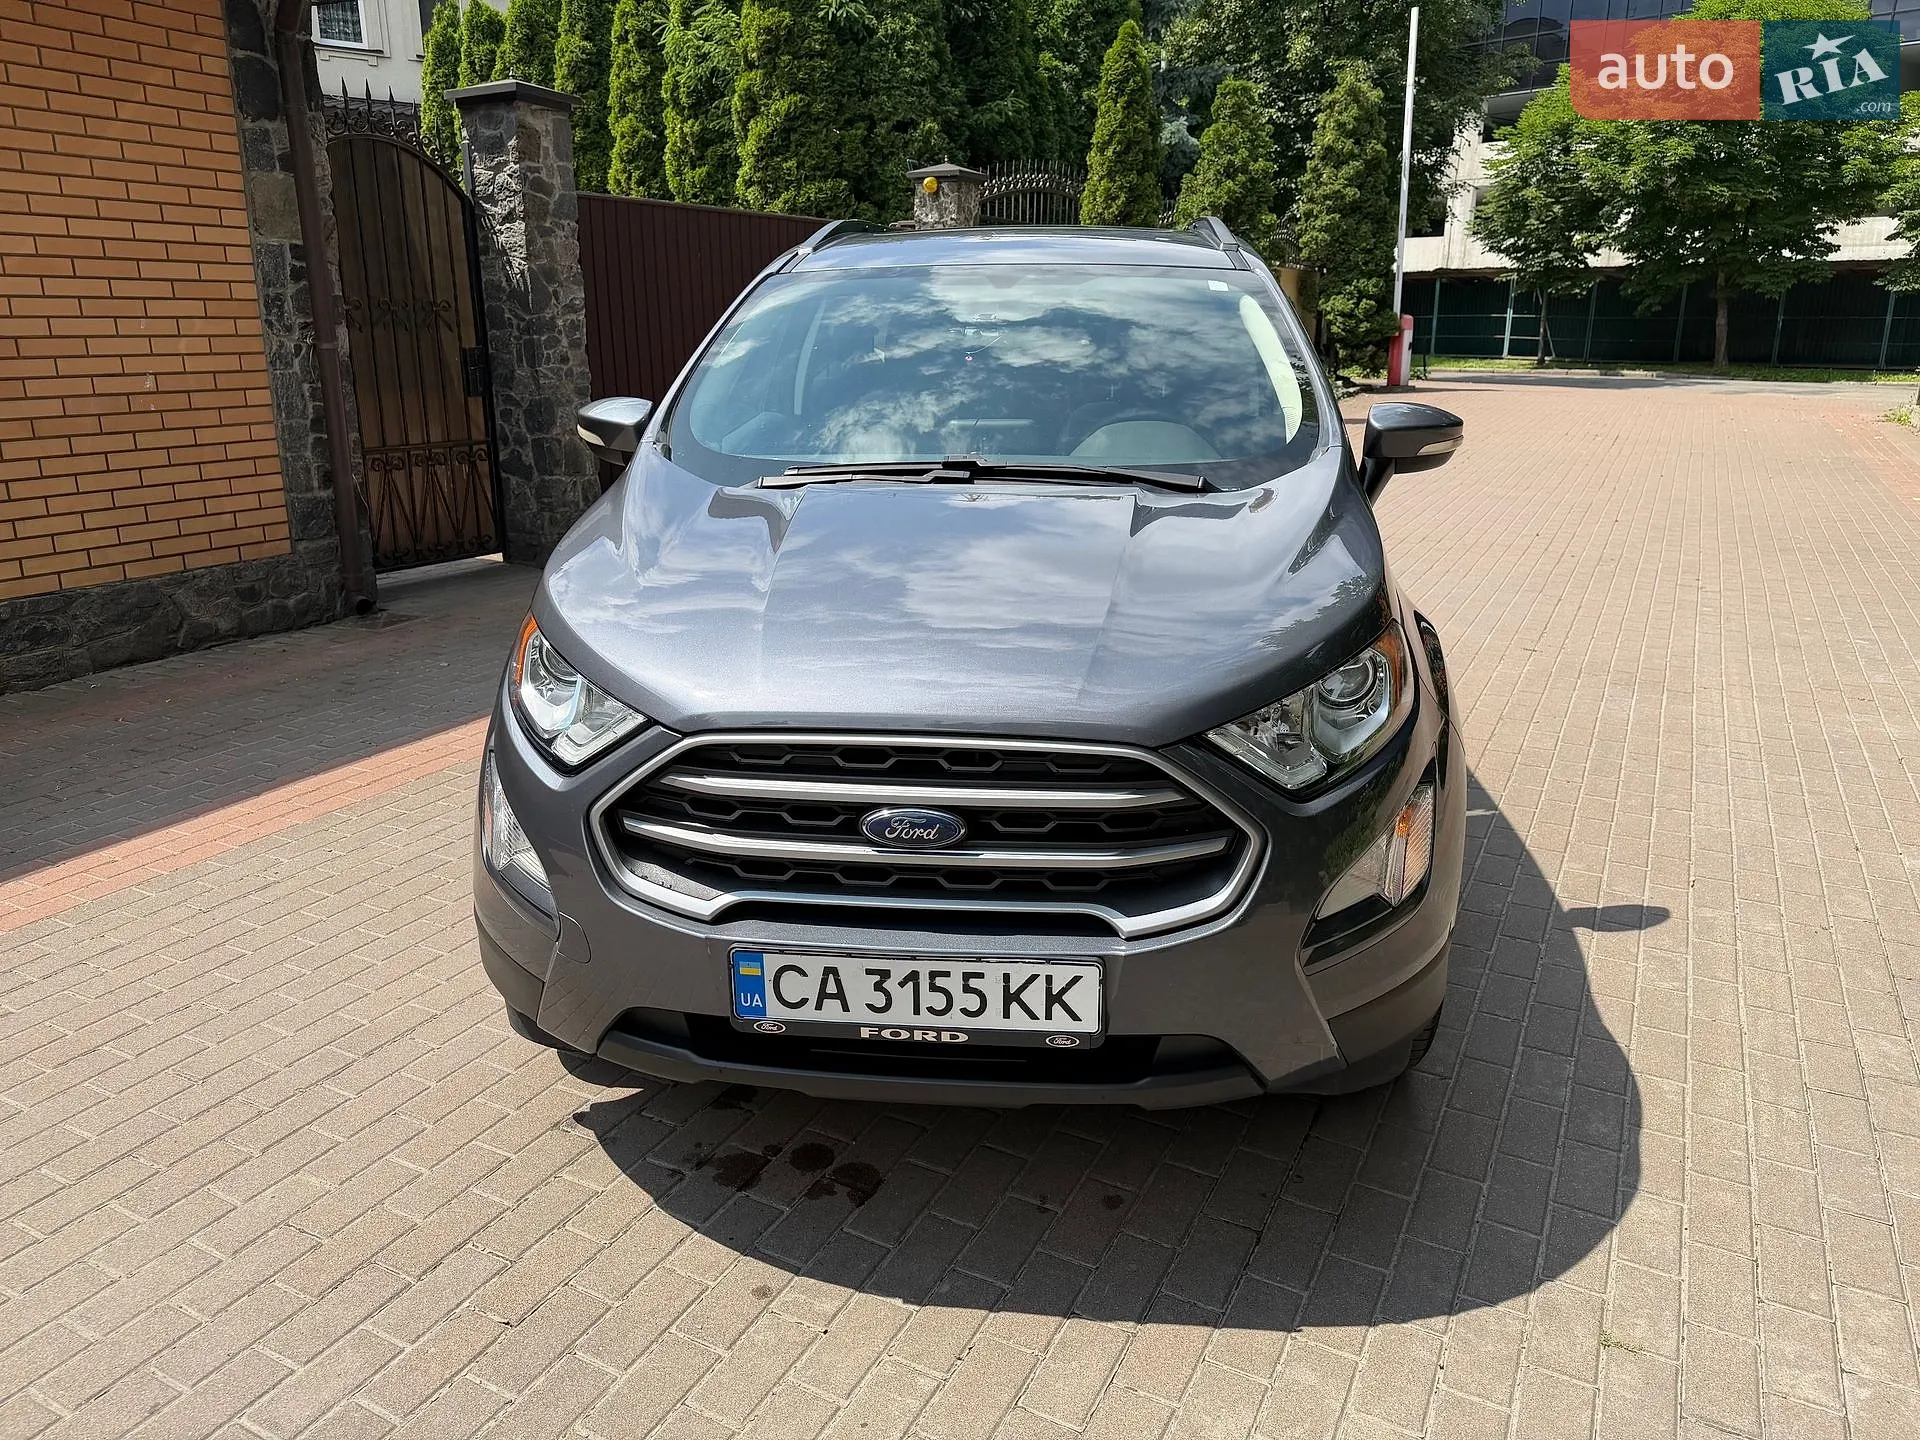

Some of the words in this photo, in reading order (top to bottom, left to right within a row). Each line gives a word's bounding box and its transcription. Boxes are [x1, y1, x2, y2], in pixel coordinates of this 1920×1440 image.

[885, 816, 940, 840] Ford
[741, 992, 763, 1008] UA
[772, 964, 850, 1013] CA
[864, 968, 988, 1018] 3155
[1002, 972, 1084, 1022] KK
[860, 1026, 969, 1044] FORD
